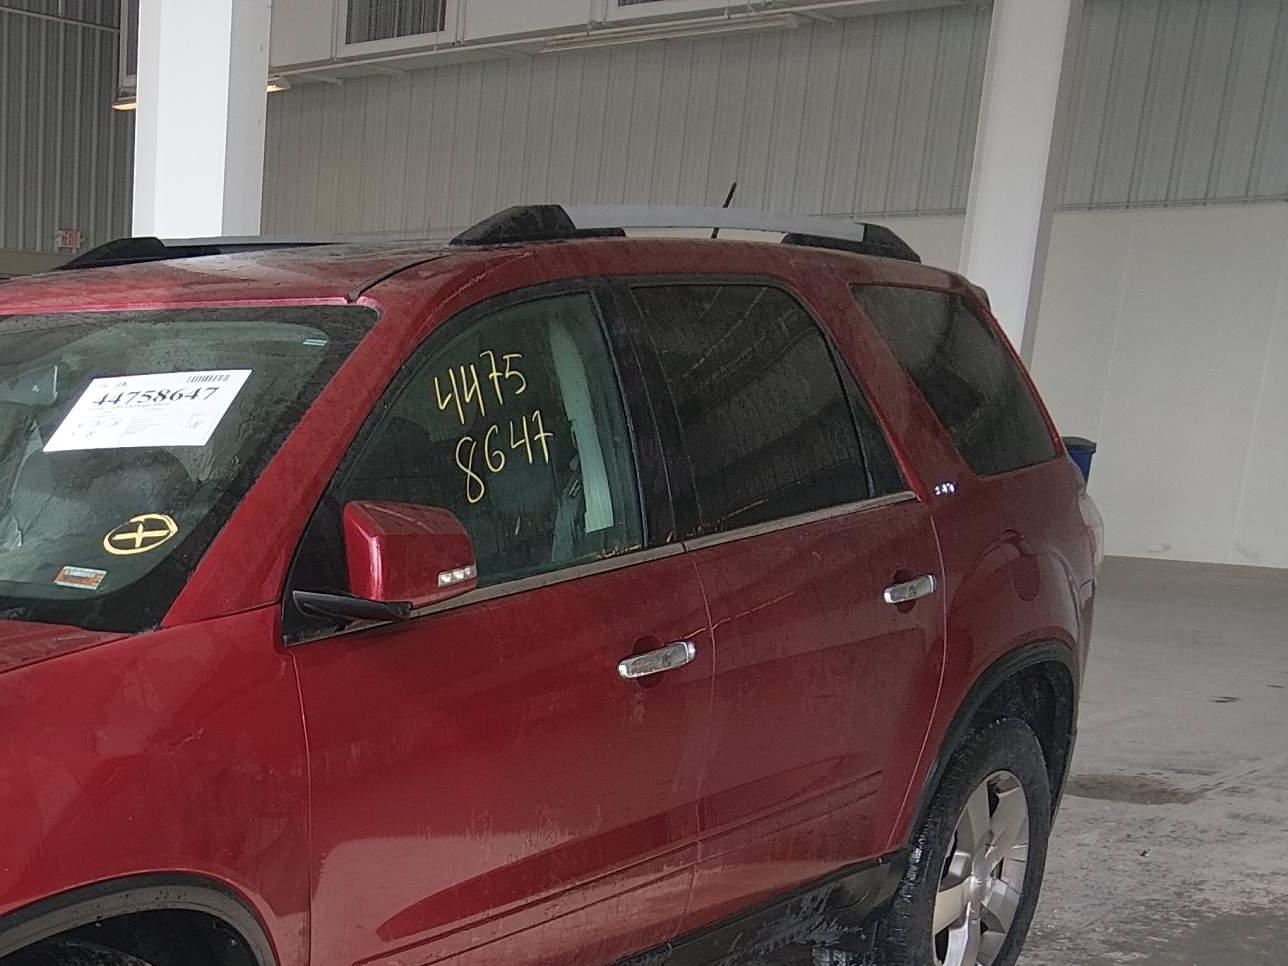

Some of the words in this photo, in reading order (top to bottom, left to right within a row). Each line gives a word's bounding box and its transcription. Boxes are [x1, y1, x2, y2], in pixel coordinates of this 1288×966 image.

[92, 386, 220, 406] 44758647
[434, 350, 527, 425] 4475
[455, 409, 554, 504] 8647
